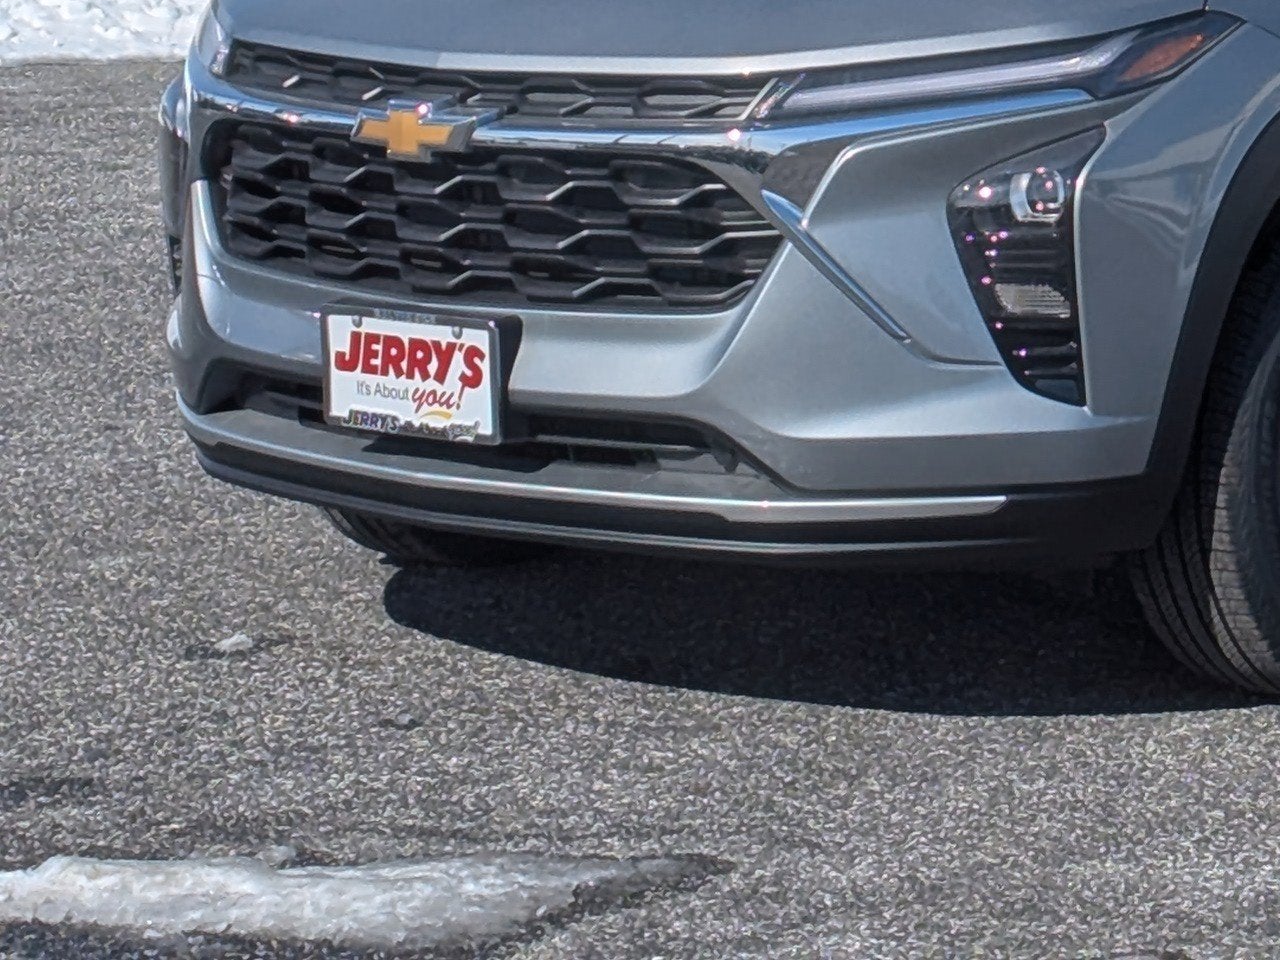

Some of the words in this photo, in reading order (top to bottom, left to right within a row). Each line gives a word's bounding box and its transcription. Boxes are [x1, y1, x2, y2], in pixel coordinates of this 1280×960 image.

[334, 330, 486, 389] JERRY'S
[356, 380, 372, 396] It's
[374, 382, 409, 401] About
[411, 385, 465, 415] you!
